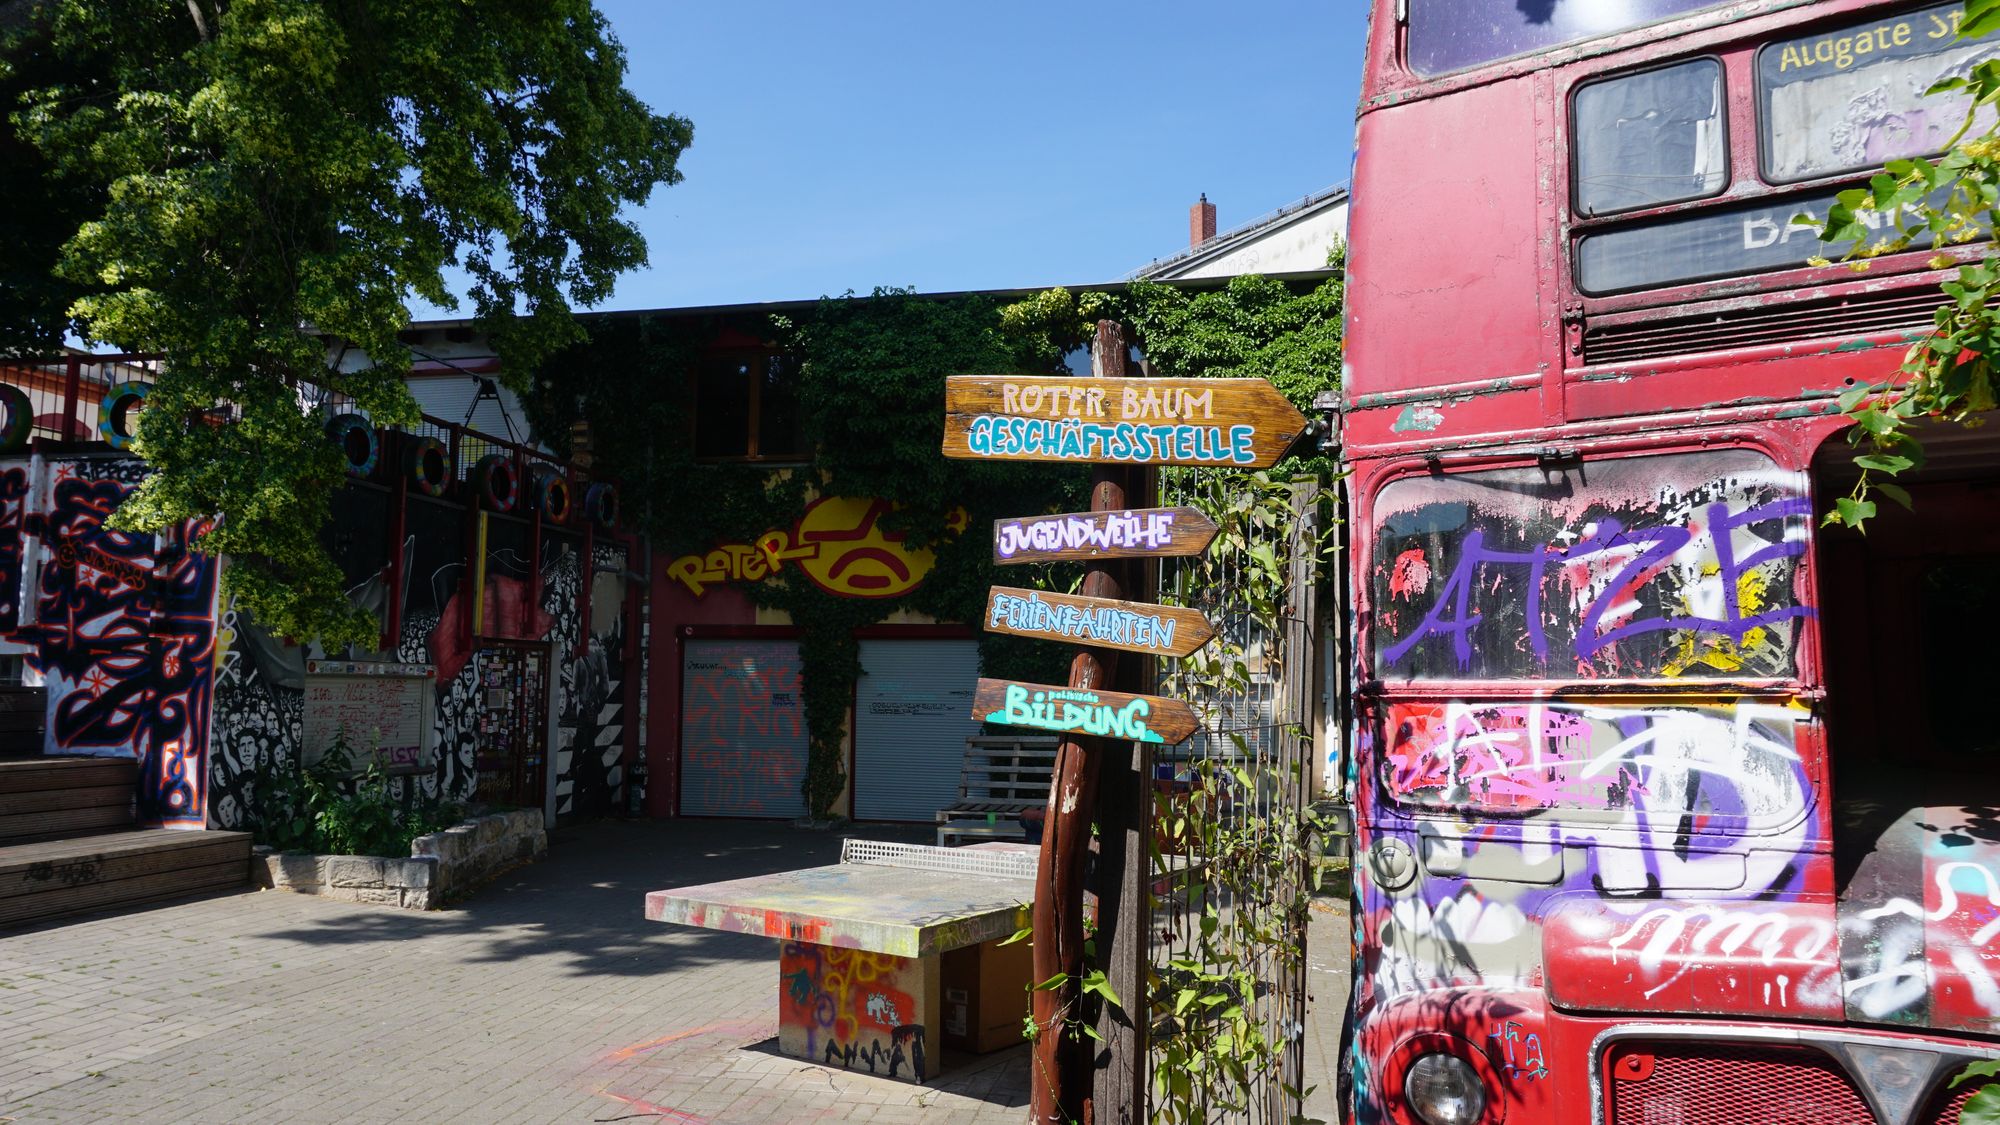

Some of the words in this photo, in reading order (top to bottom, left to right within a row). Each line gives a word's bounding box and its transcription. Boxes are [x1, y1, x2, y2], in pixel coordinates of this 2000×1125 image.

[1003, 384, 1105, 419] ROTER
[1121, 387, 1213, 420] BAUM
[968, 416, 1256, 465] GESCHÄFTSSTELLE
[990, 593, 1176, 649] FERIENFAHRTEN
[1048, 690, 1099, 703] politische
